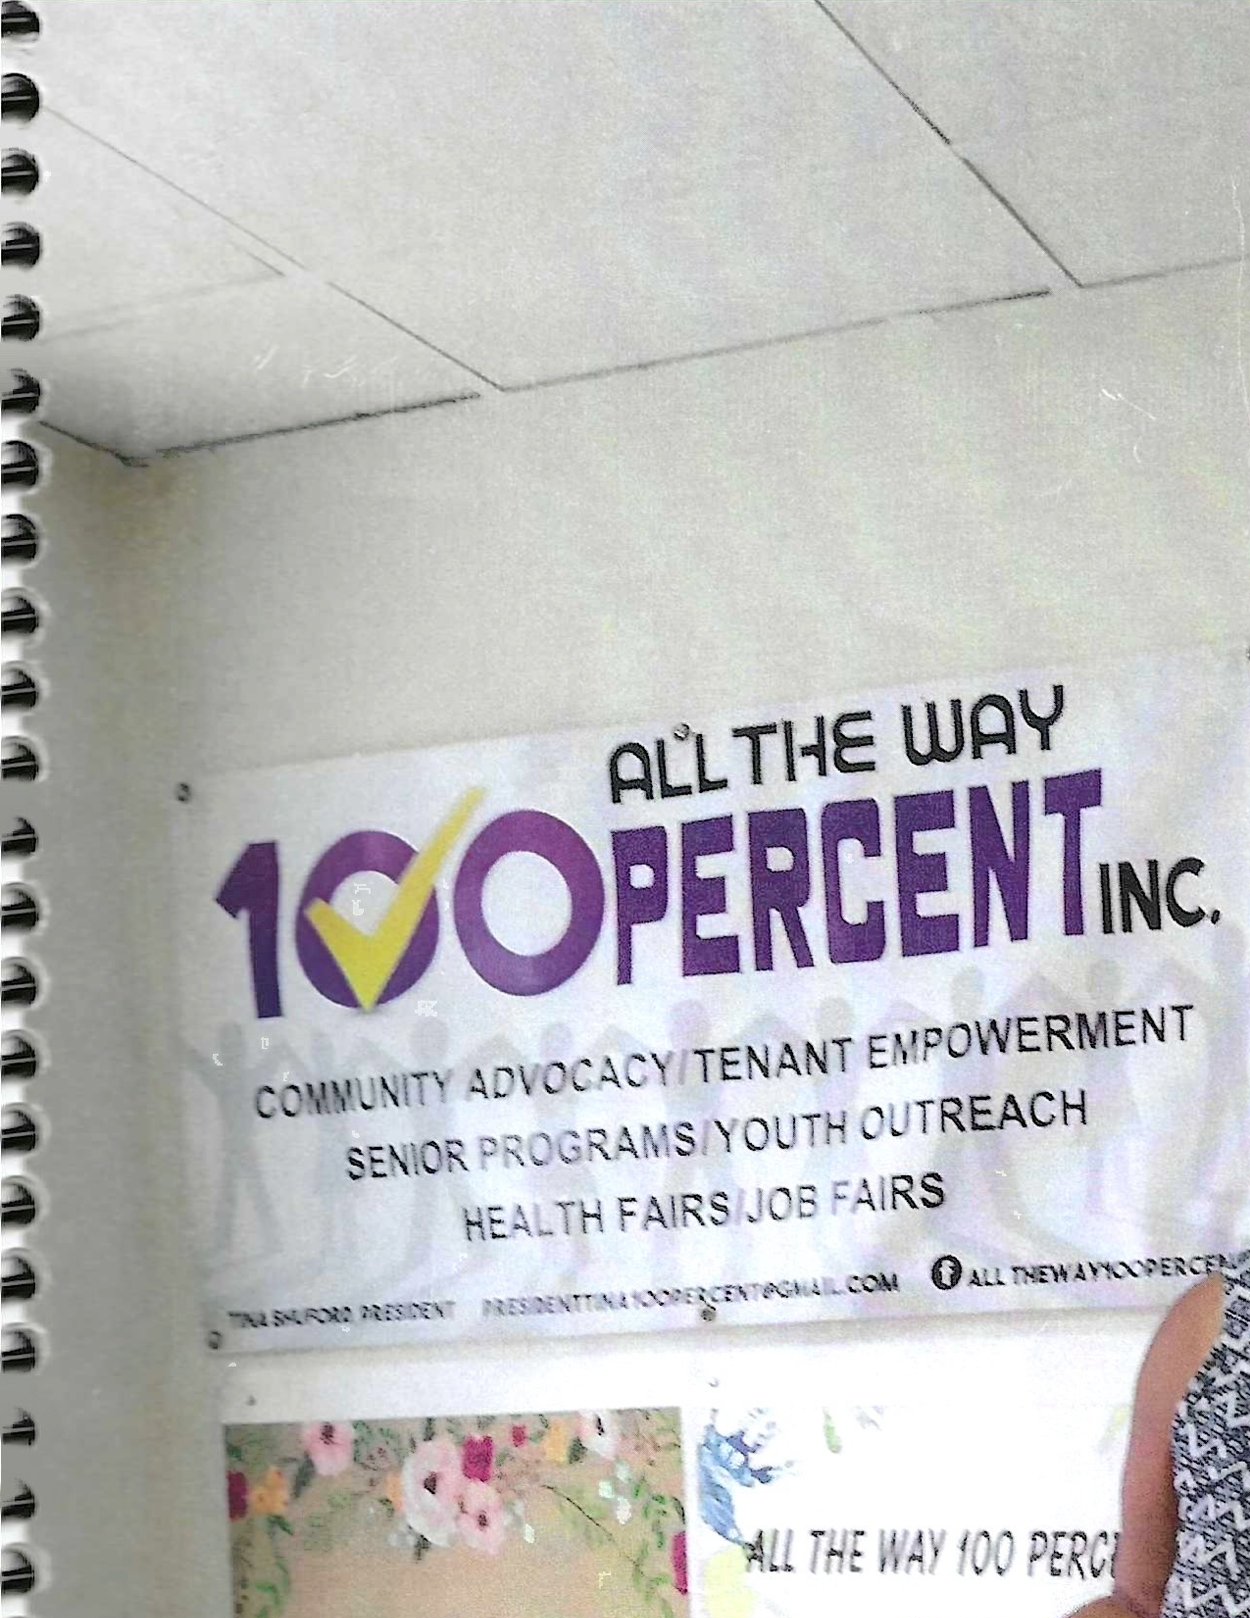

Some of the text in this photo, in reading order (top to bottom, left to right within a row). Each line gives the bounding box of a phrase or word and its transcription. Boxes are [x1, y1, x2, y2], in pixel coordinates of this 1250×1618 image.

[609, 685, 1064, 803] ALL THE WAY
[214, 768, 1221, 1018] 100 PERCENT INC.
[254, 1068, 452, 1119] COMMUNITY
[868, 1004, 1195, 1069] EMPOWERMENT
[346, 1138, 470, 1180] SENIOR
[860, 1089, 1089, 1140] OUTREACH
[464, 1198, 602, 1242] HEALTH
[831, 1171, 946, 1216] FAIRS
[743, 1529, 796, 1573] ALL
[809, 1529, 866, 1574] THE
[877, 1529, 947, 1574] WAY
[957, 1530, 1015, 1576] 100
